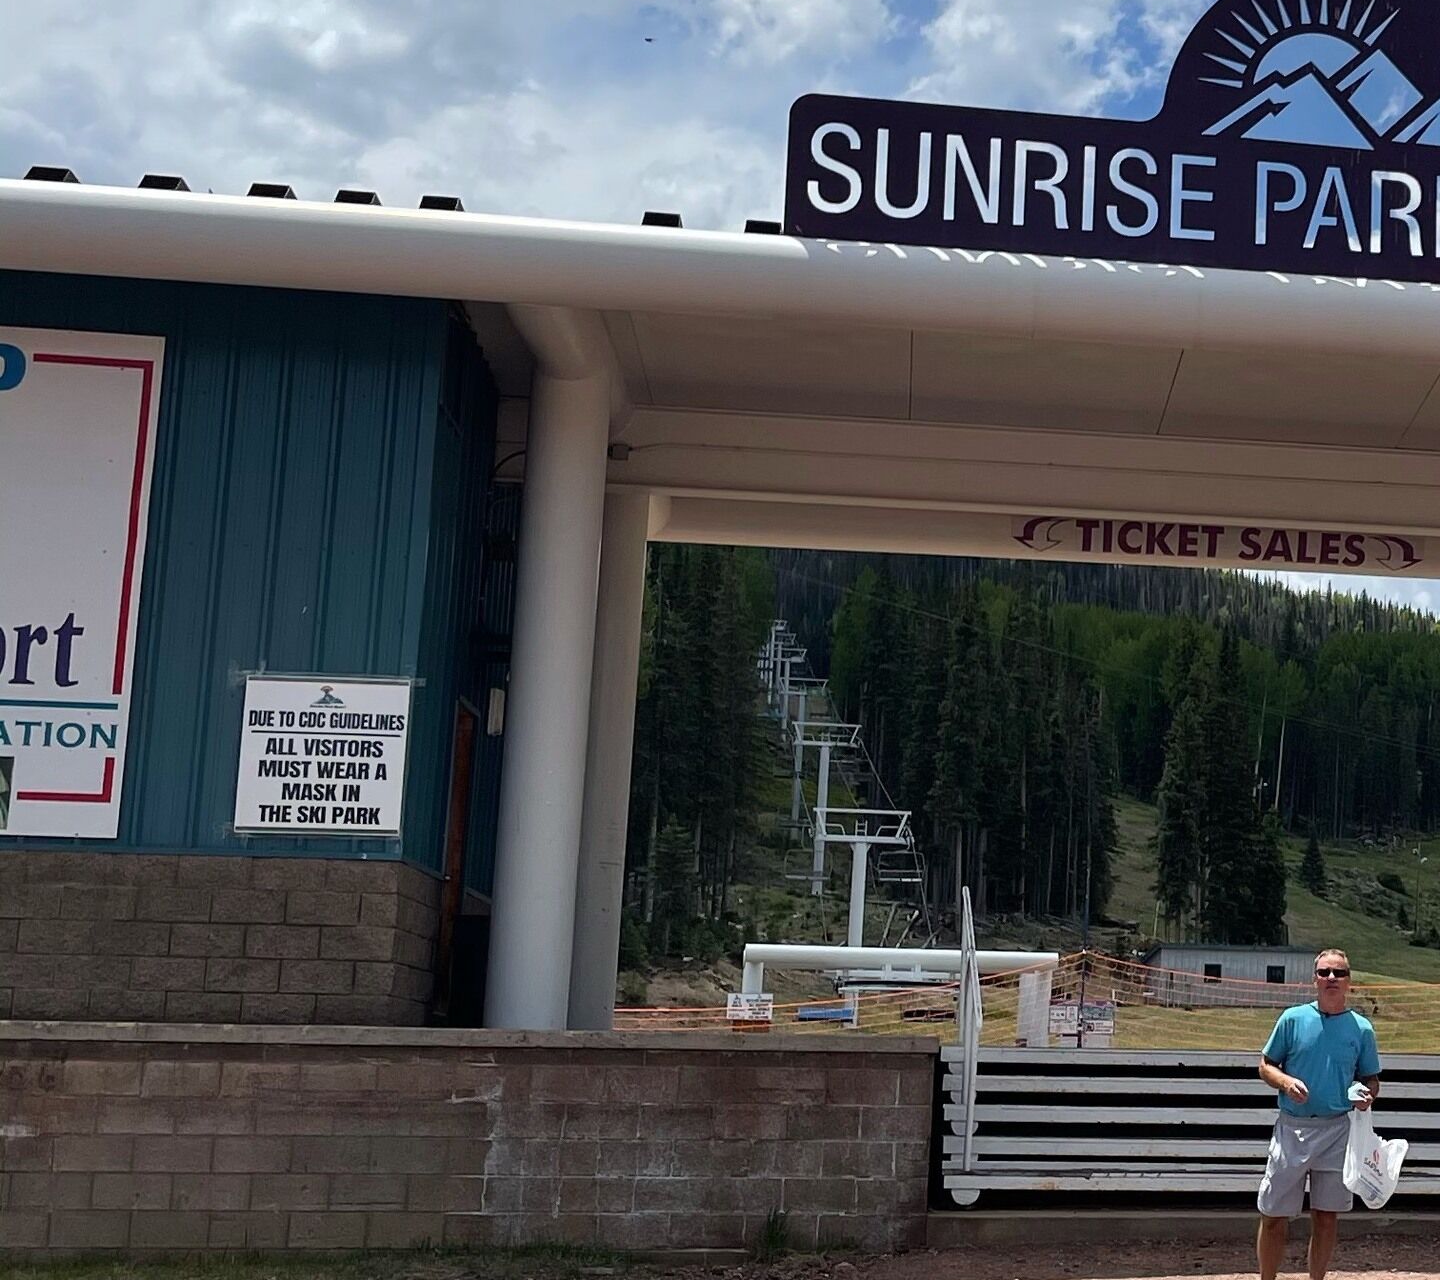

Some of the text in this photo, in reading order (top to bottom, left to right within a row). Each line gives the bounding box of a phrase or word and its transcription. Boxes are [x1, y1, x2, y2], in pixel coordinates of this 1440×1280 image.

[807, 122, 1216, 241] SUNRISE
[1076, 520, 1365, 567] TICKET SALES
[0, 613, 84, 687] rt
[249, 710, 405, 731] DUE TO CDC GUIDELINES
[265, 738, 383, 758] ALL VISITORS
[258, 760, 387, 781] MUST WEAR A
[281, 783, 360, 802] MASK IN
[259, 805, 381, 825] THE SKI PARK
